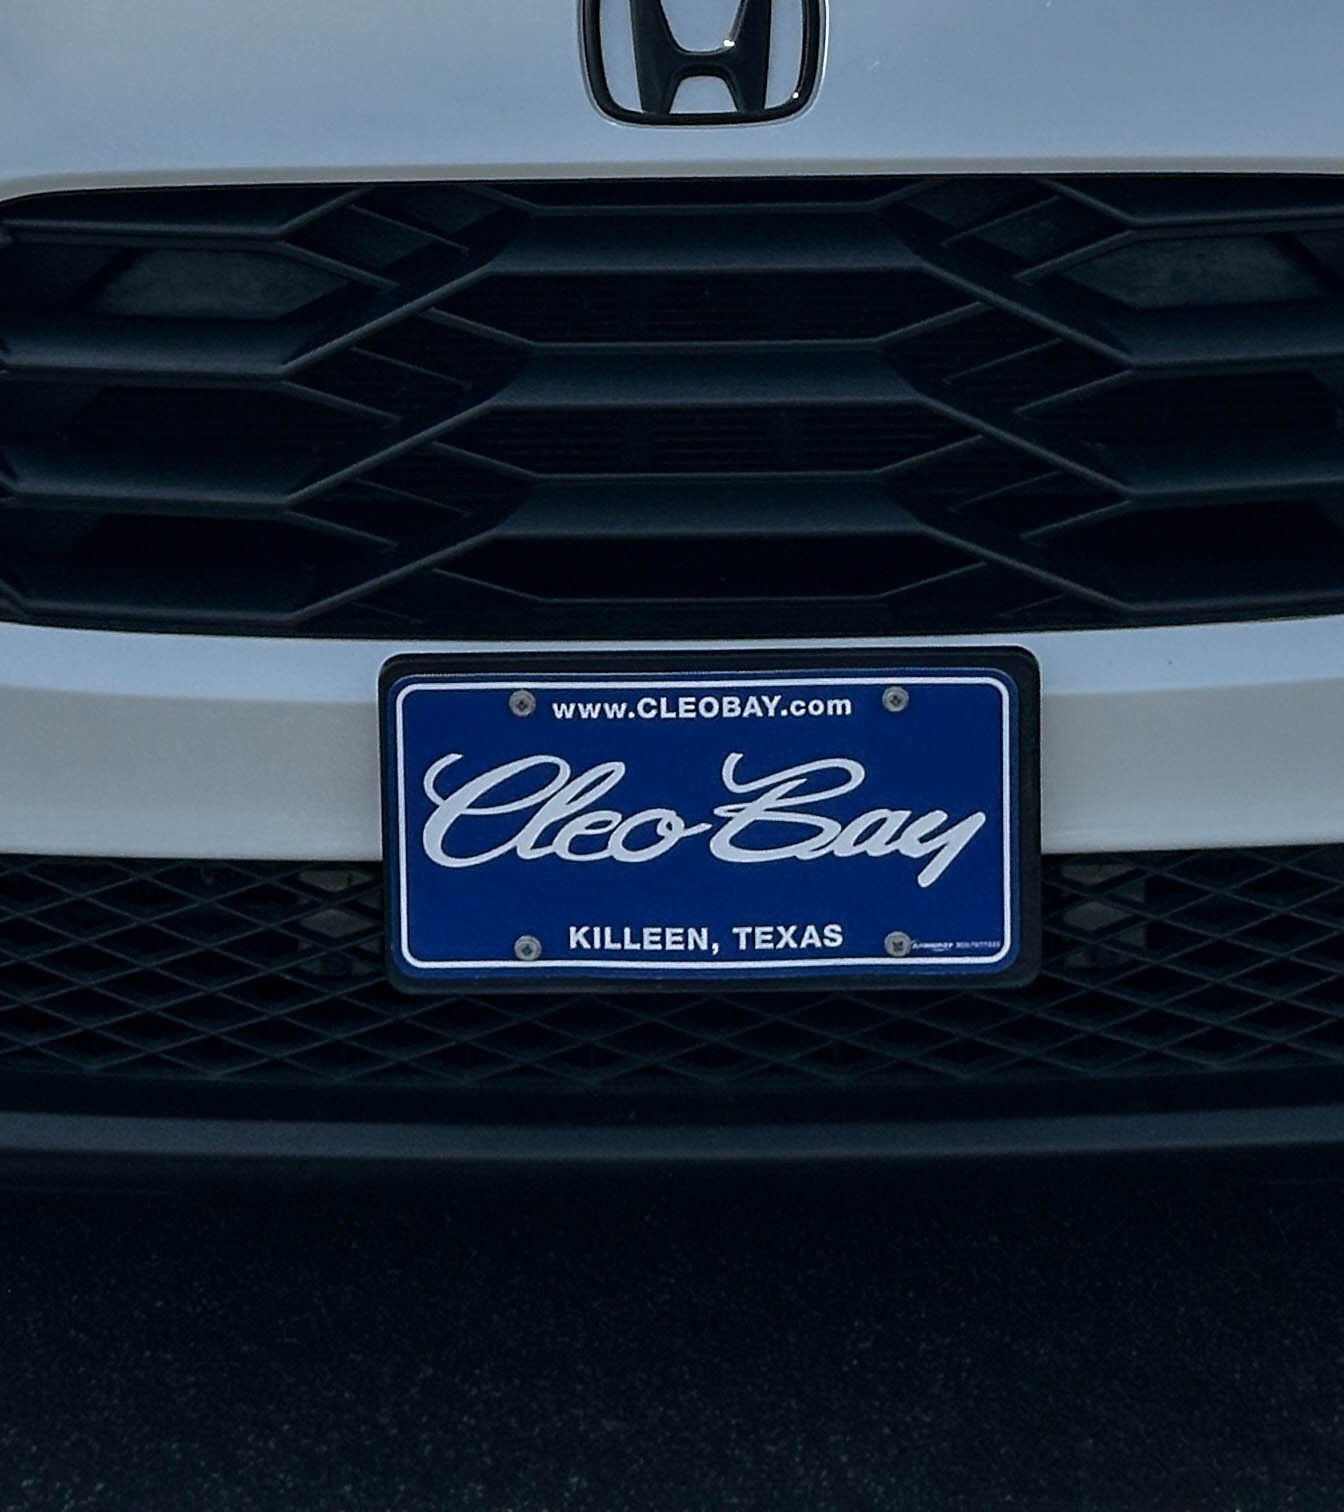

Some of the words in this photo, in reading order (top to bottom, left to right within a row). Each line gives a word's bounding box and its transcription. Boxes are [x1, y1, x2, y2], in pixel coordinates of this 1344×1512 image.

[551, 694, 853, 720] www.CLEOBAY.com
[422, 752, 712, 869] Cleo
[710, 751, 986, 889] Bay
[568, 926, 722, 955] KILLEEN,
[731, 924, 844, 951] TEXAS
